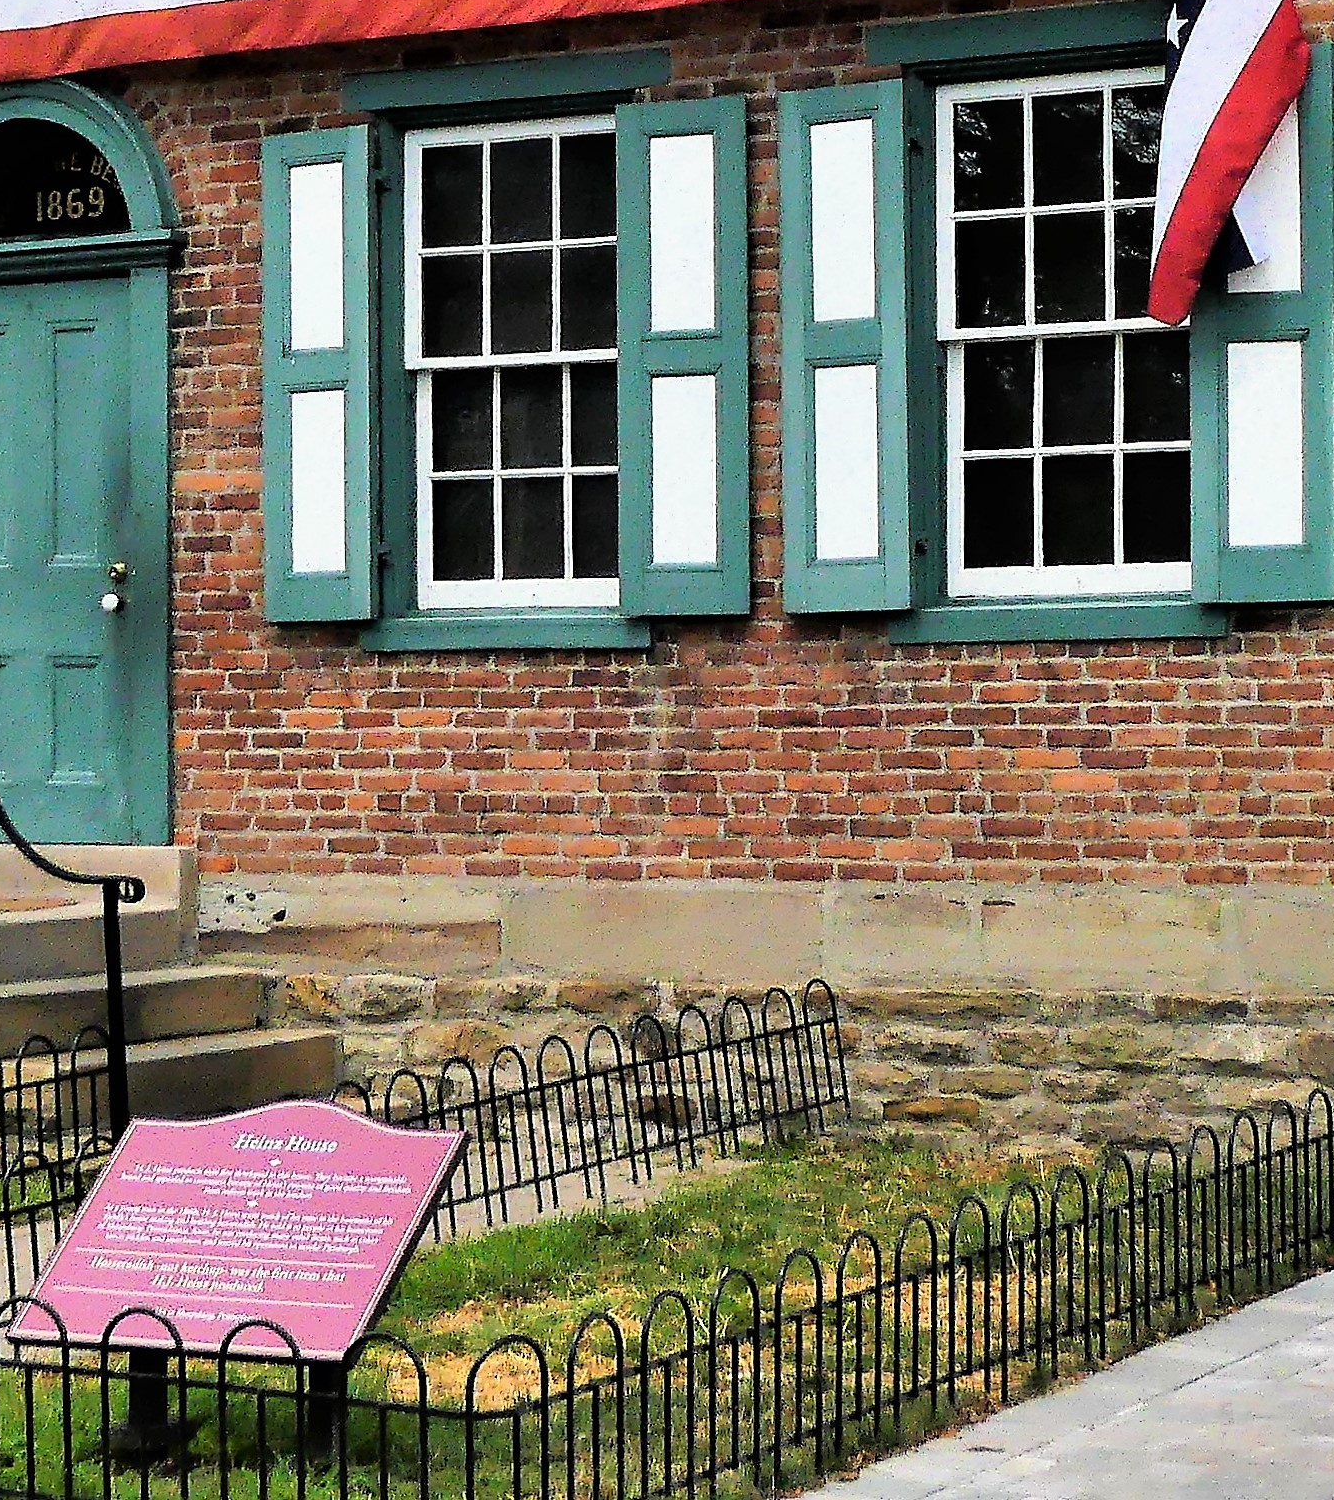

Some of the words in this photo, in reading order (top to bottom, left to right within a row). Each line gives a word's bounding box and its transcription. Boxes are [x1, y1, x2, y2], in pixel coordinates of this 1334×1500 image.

[36, 186, 105, 221] 1869
[233, 1133, 284, 1150] Heinz
[285, 1135, 339, 1153] House
[321, 1269, 346, 1282] that
